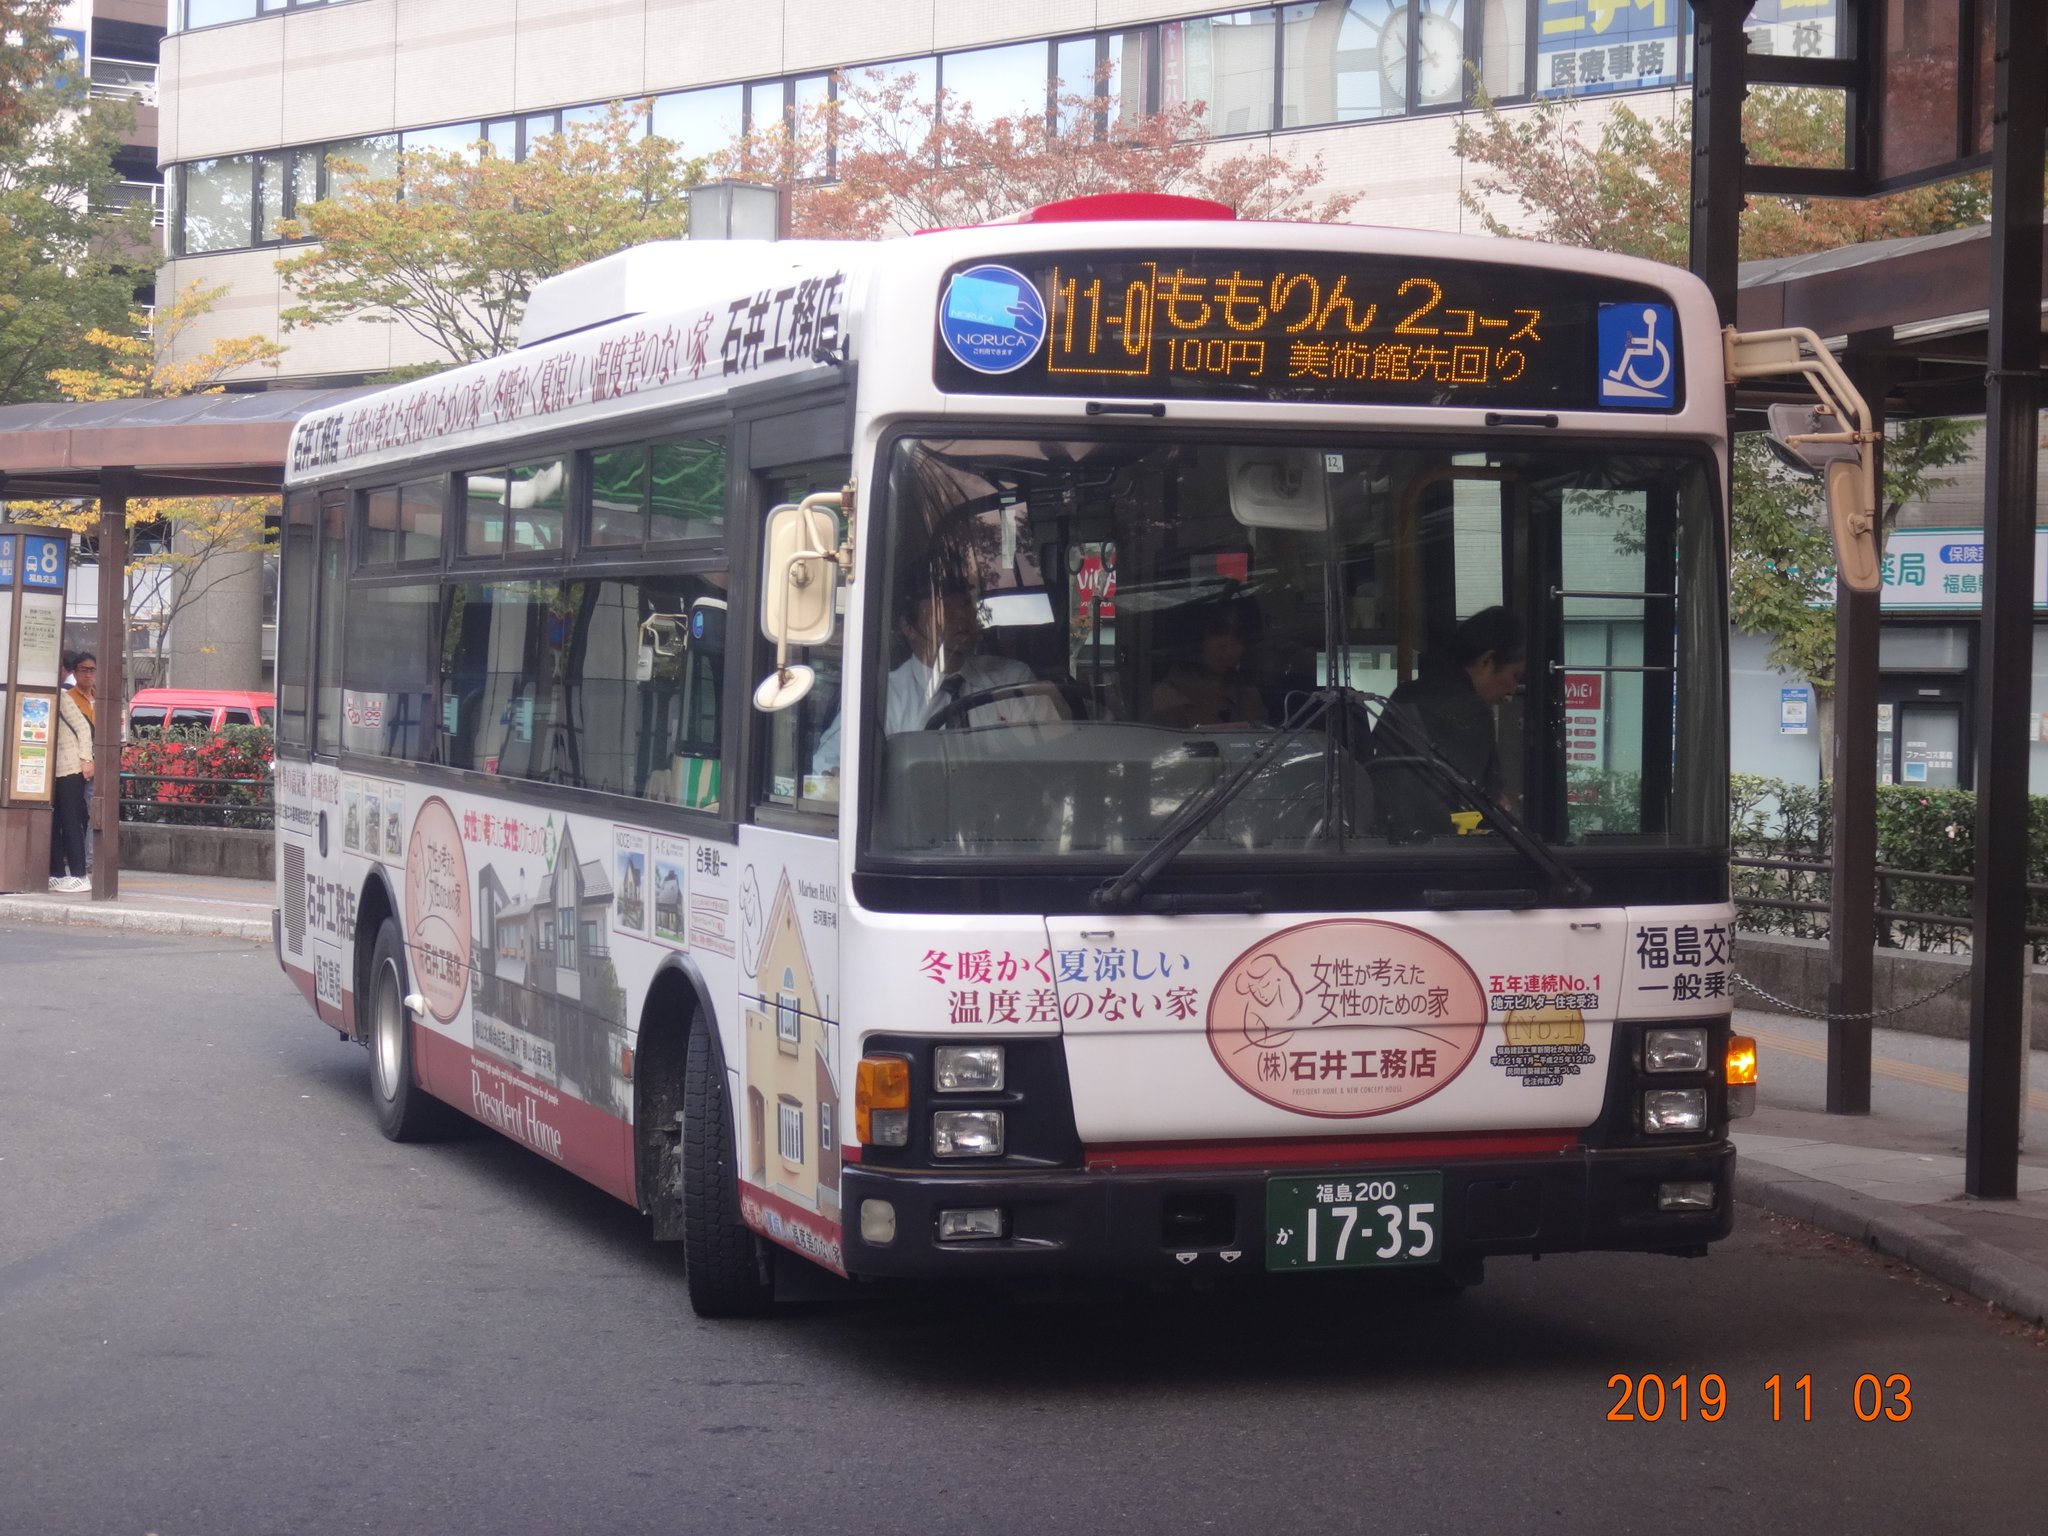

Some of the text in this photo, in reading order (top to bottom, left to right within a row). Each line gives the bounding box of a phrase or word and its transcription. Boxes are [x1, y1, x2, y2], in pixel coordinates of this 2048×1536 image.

[1551, 41, 1665, 87] 医療事務
[1060, 278, 1149, 354] 11-0
[1157, 268, 1377, 332] ももりん
[957, 334, 1027, 347] NORUCA
[1169, 338, 1526, 383] 100円 美術館先回り
[2, 541, 10, 556] 8
[41, 543, 57, 573] 8
[920, 947, 1190, 985] 冬暖かく夏涼しい
[1305, 955, 1426, 995] 女性が考えた
[1489, 975, 1601, 993] 五年連続No.1
[948, 985, 1199, 1025] 温度差のない家
[1311, 985, 1450, 1025] 女性のための家
[1492, 993, 1599, 1010] 地元ビルダー住宅受注
[1292, 1087, 1320, 1096] PRESIDENT
[1322, 1087, 1337, 1095] HOME
[1346, 1086, 1359, 1095] NEW
[1360, 1086, 1384, 1094] CONCEPT
[1385, 1085, 1403, 1093] HOUSE
[471, 1069, 564, 1161] President Home
[1276, 1203, 1435, 1263] か 17-35
